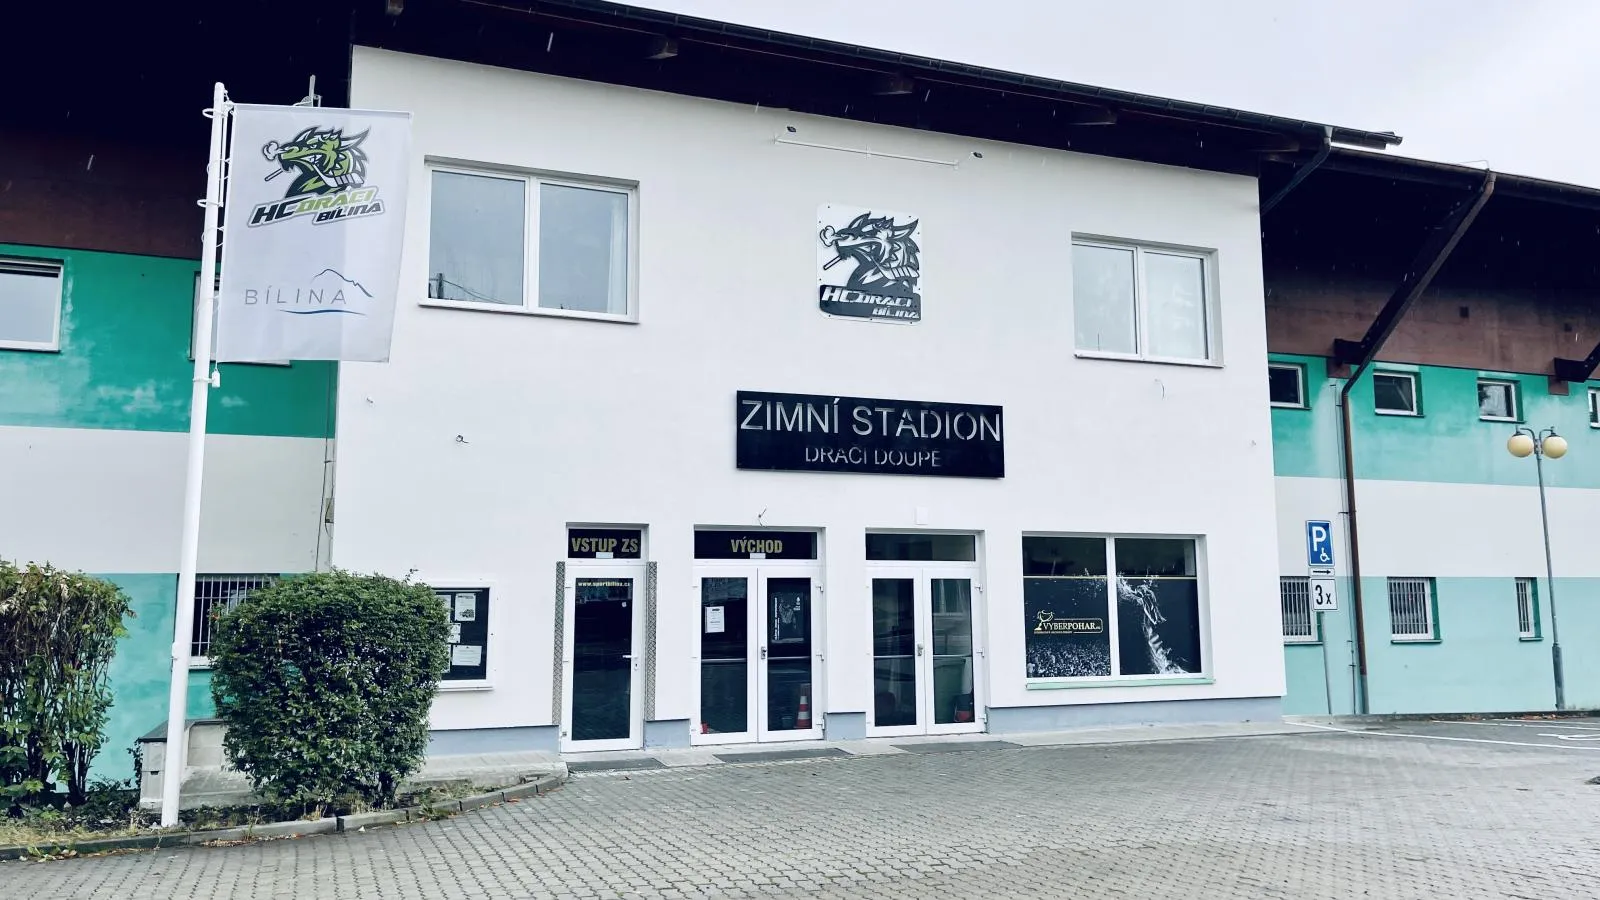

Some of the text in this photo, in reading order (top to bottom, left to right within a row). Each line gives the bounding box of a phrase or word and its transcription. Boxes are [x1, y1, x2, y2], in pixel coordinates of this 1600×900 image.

[244, 285, 347, 305] BÍLINA
[740, 397, 1001, 442] ZIMNÍ STADION
[571, 537, 639, 553] VSTUP ZS
[730, 536, 783, 554] VÝCHOD
[1311, 526, 1327, 552] P
